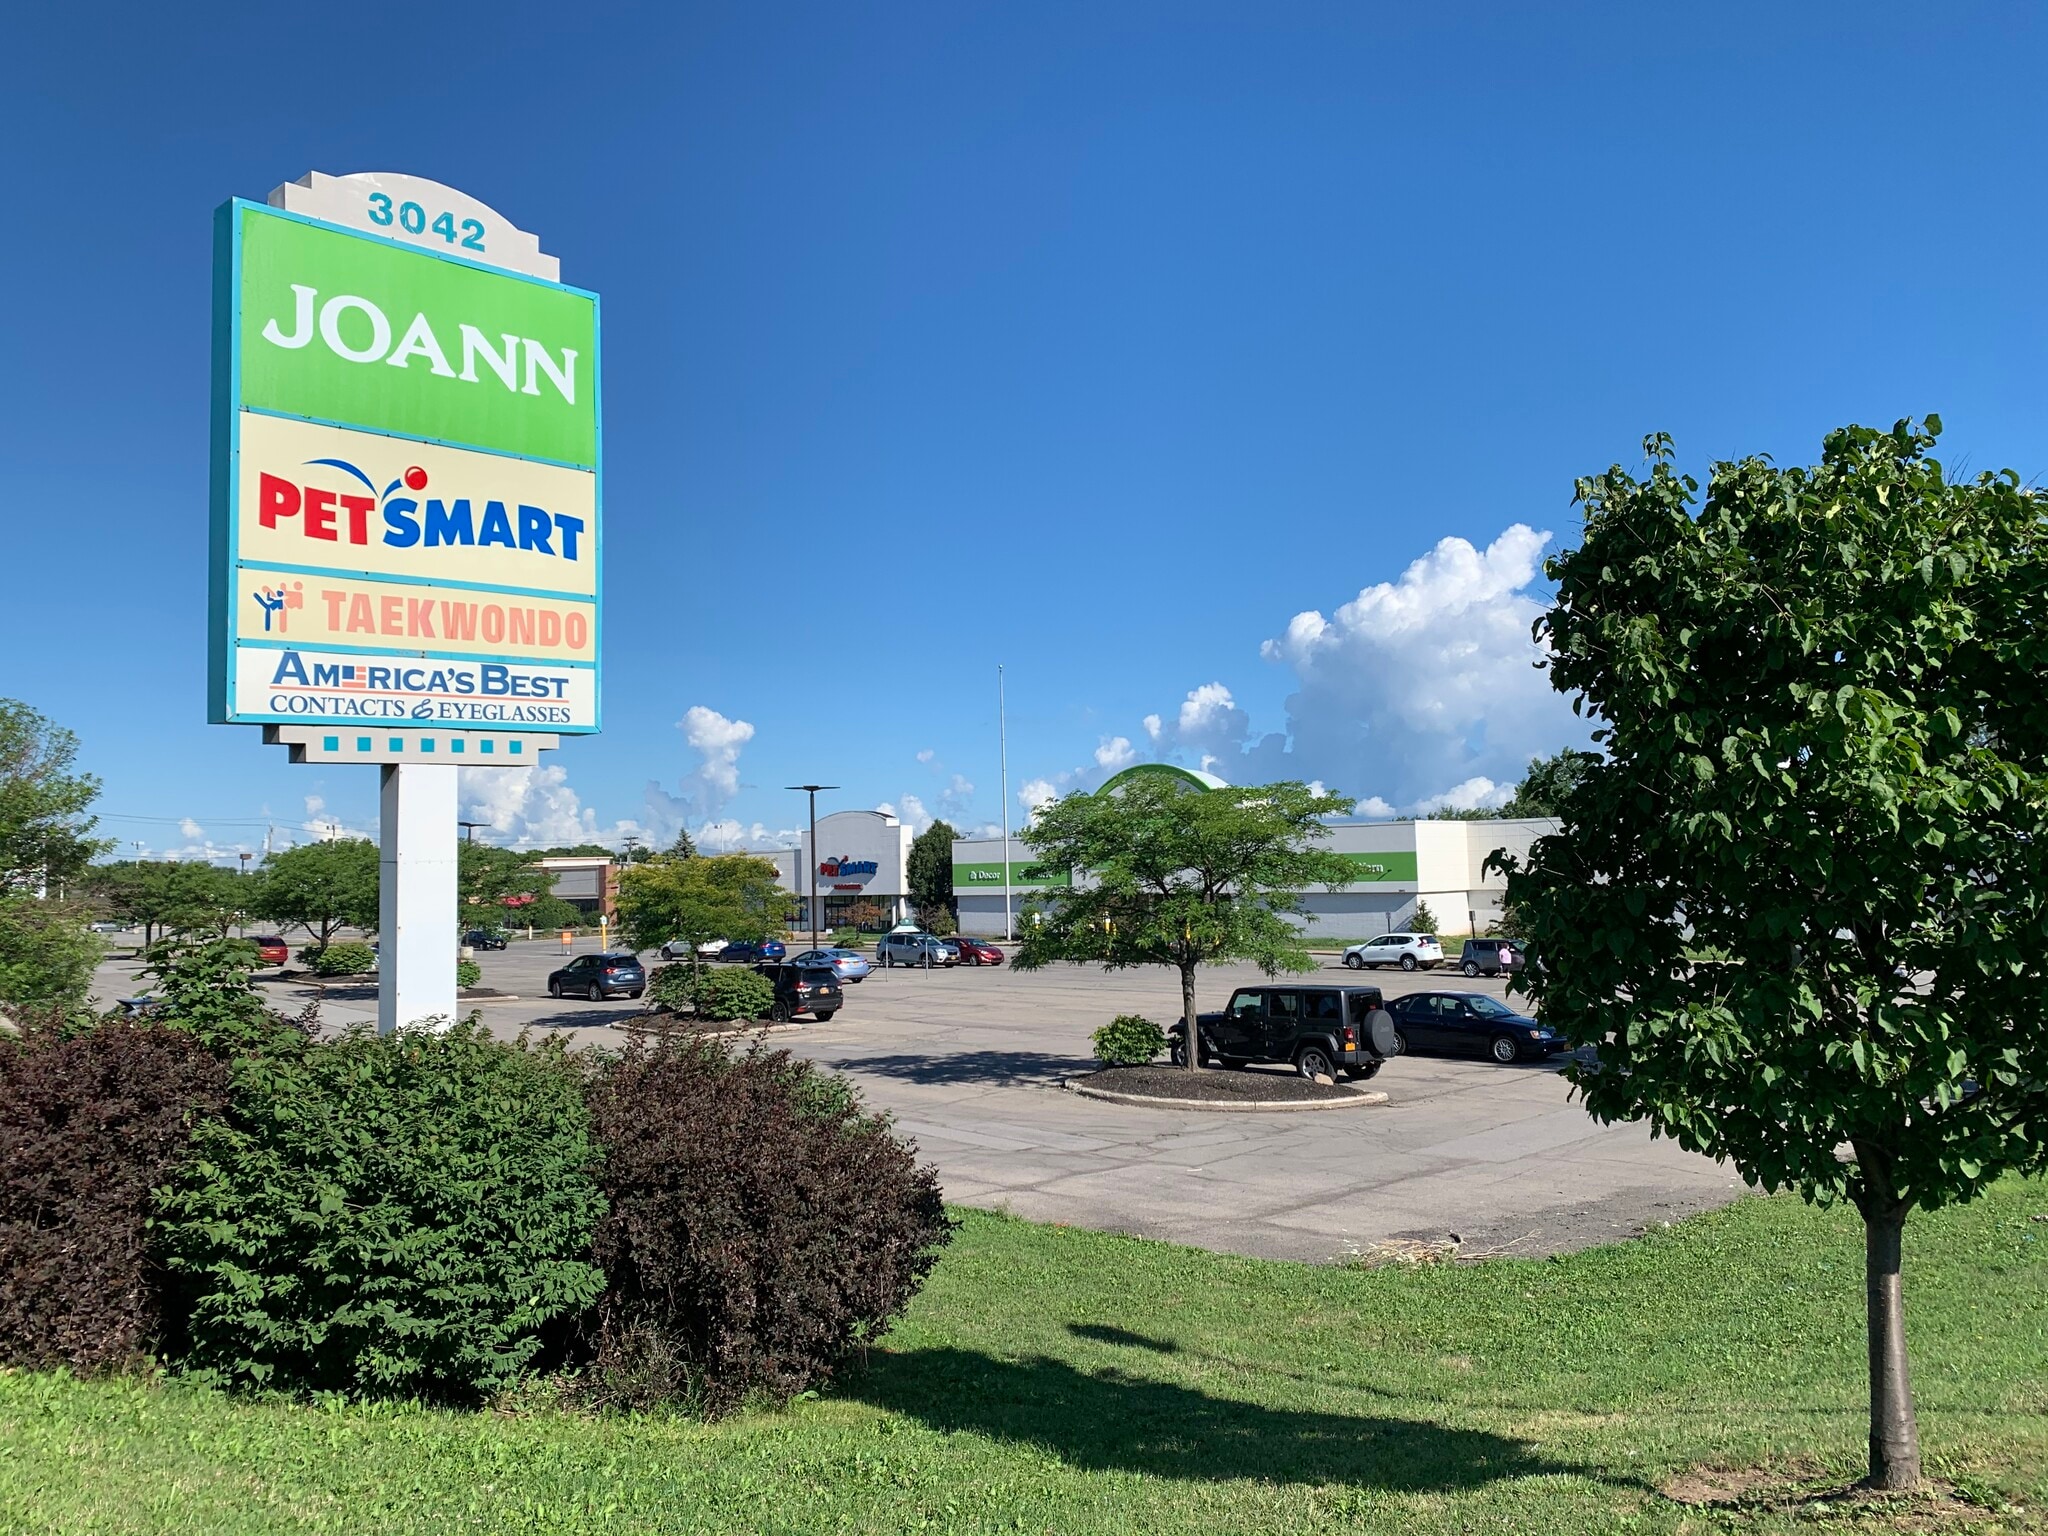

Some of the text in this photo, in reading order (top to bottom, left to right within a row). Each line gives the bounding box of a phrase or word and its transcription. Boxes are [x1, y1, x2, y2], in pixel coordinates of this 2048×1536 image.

[368, 192, 486, 252] 3042
[261, 284, 579, 405] JOANN
[259, 471, 584, 561] PETSMART
[321, 590, 587, 650] TAEKWONDO
[269, 694, 571, 723] CONTACTS & EYEGLASSES
[480, 663, 570, 698] BEST
